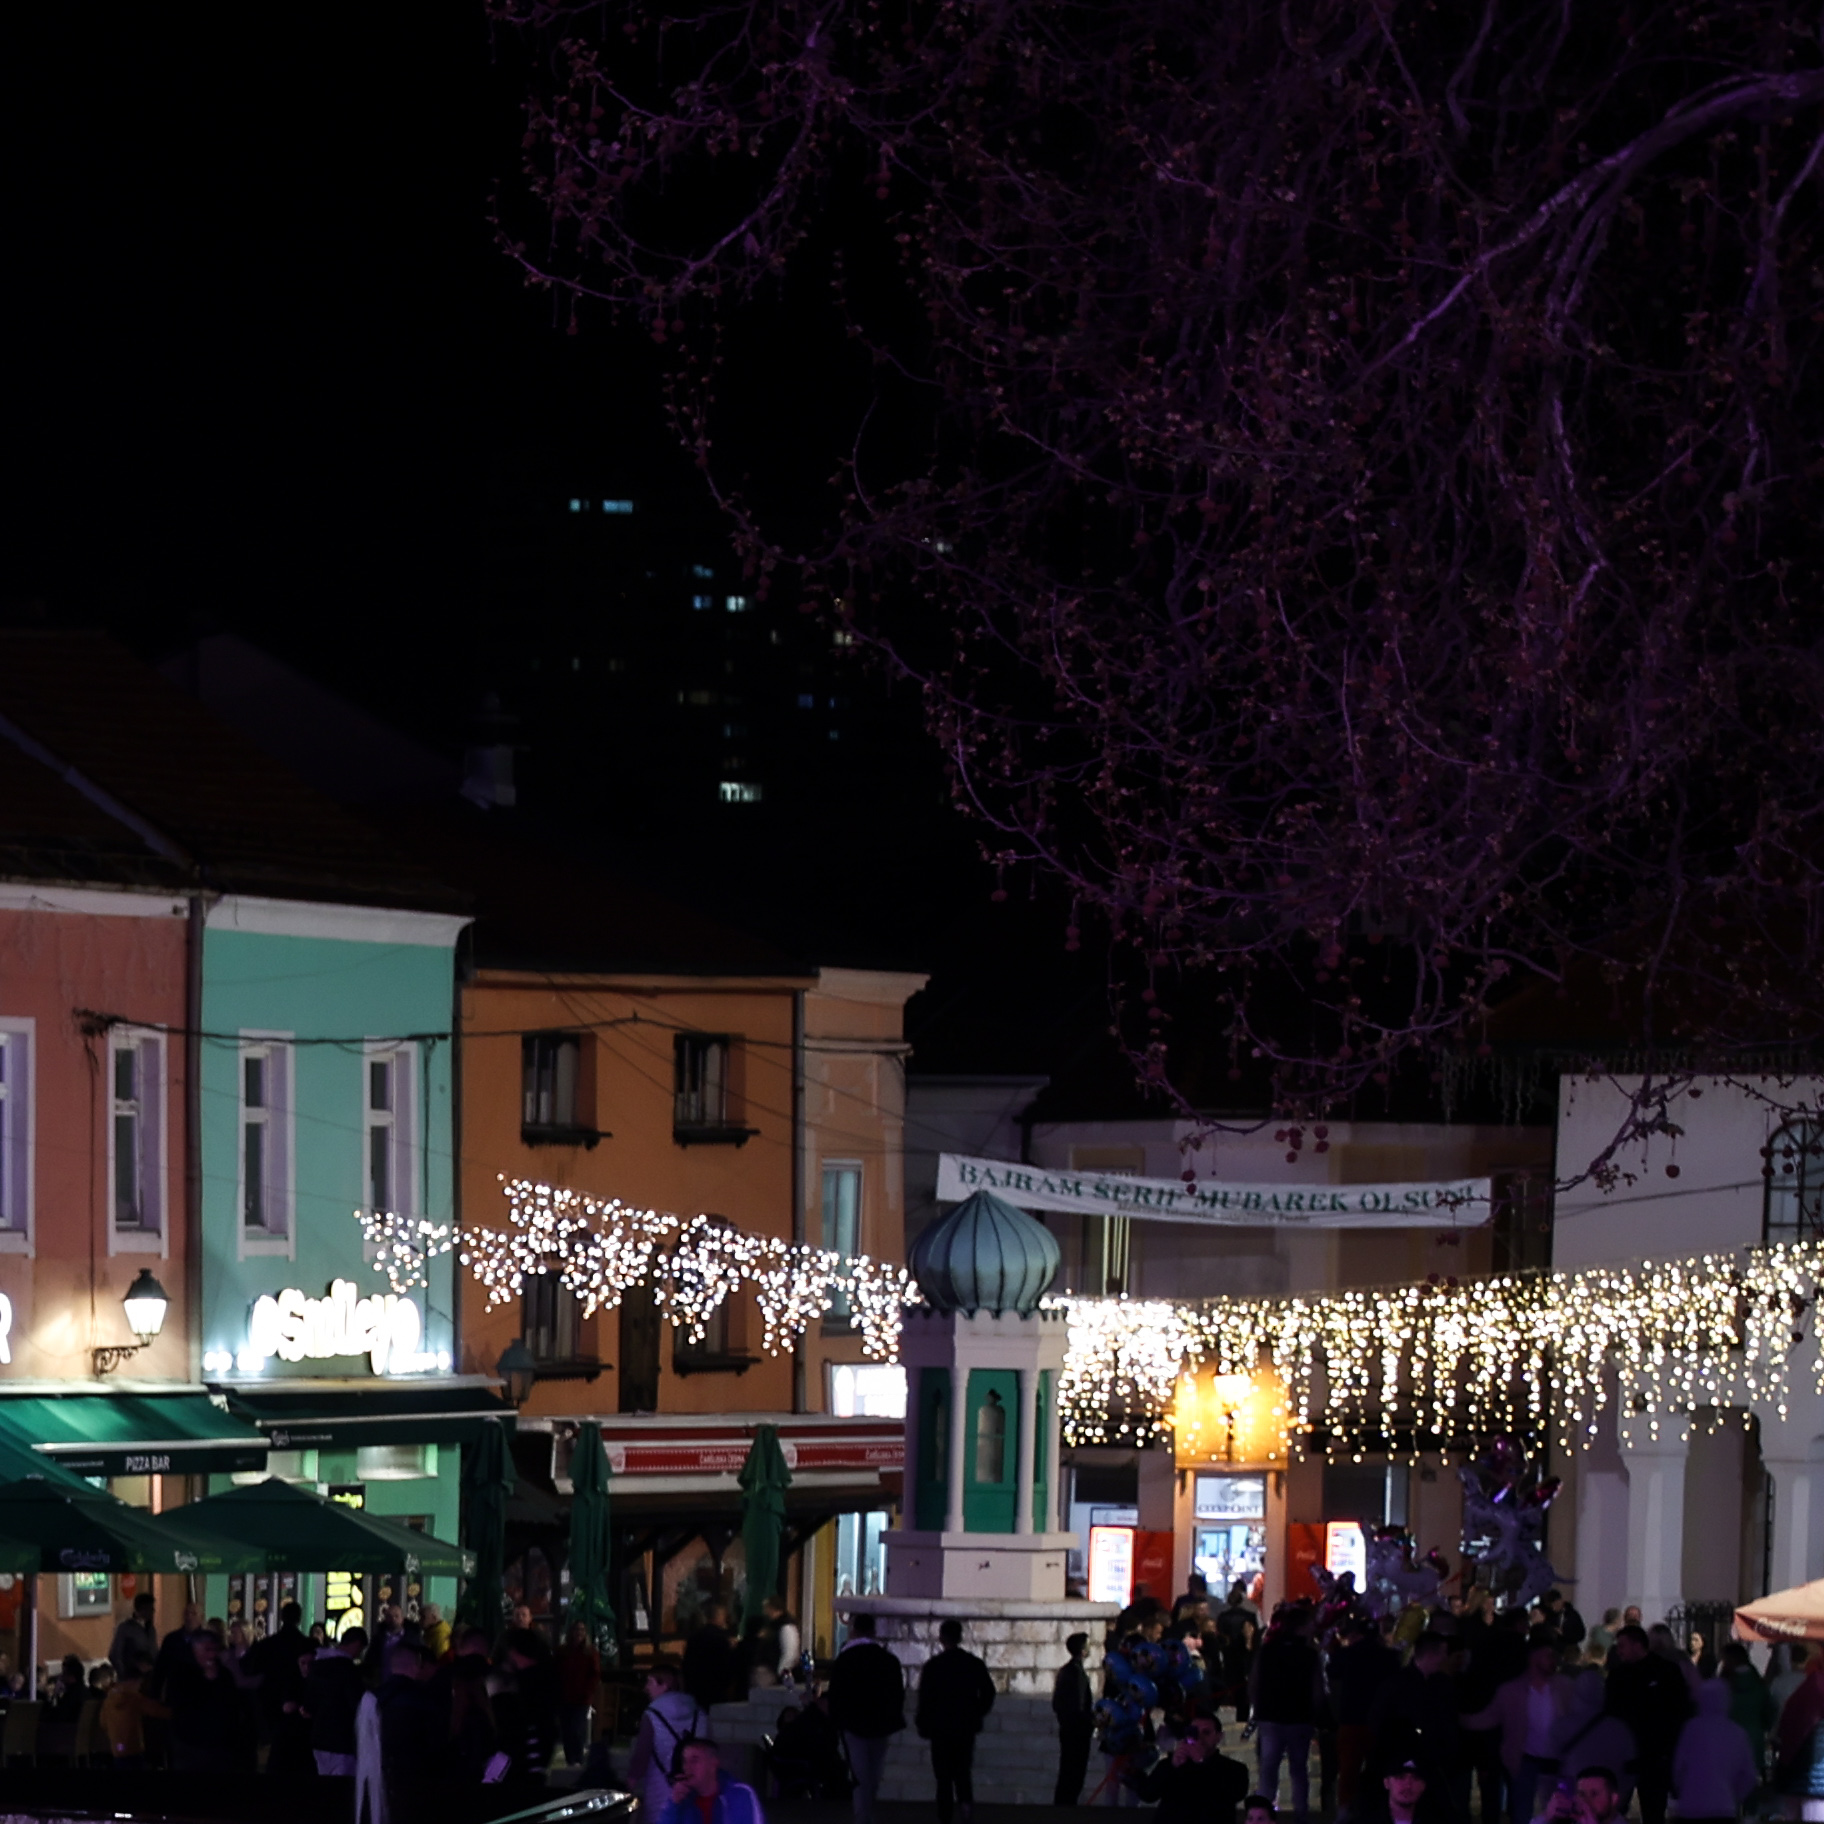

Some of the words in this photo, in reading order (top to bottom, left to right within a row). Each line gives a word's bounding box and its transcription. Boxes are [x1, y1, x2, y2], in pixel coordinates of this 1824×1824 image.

[959, 1162, 1082, 1197] BAJRAM
[1193, 1188, 1348, 1212] MUBAREK
[124, 1456, 150, 1472] PIZZA
[151, 1454, 171, 1471] BAR
